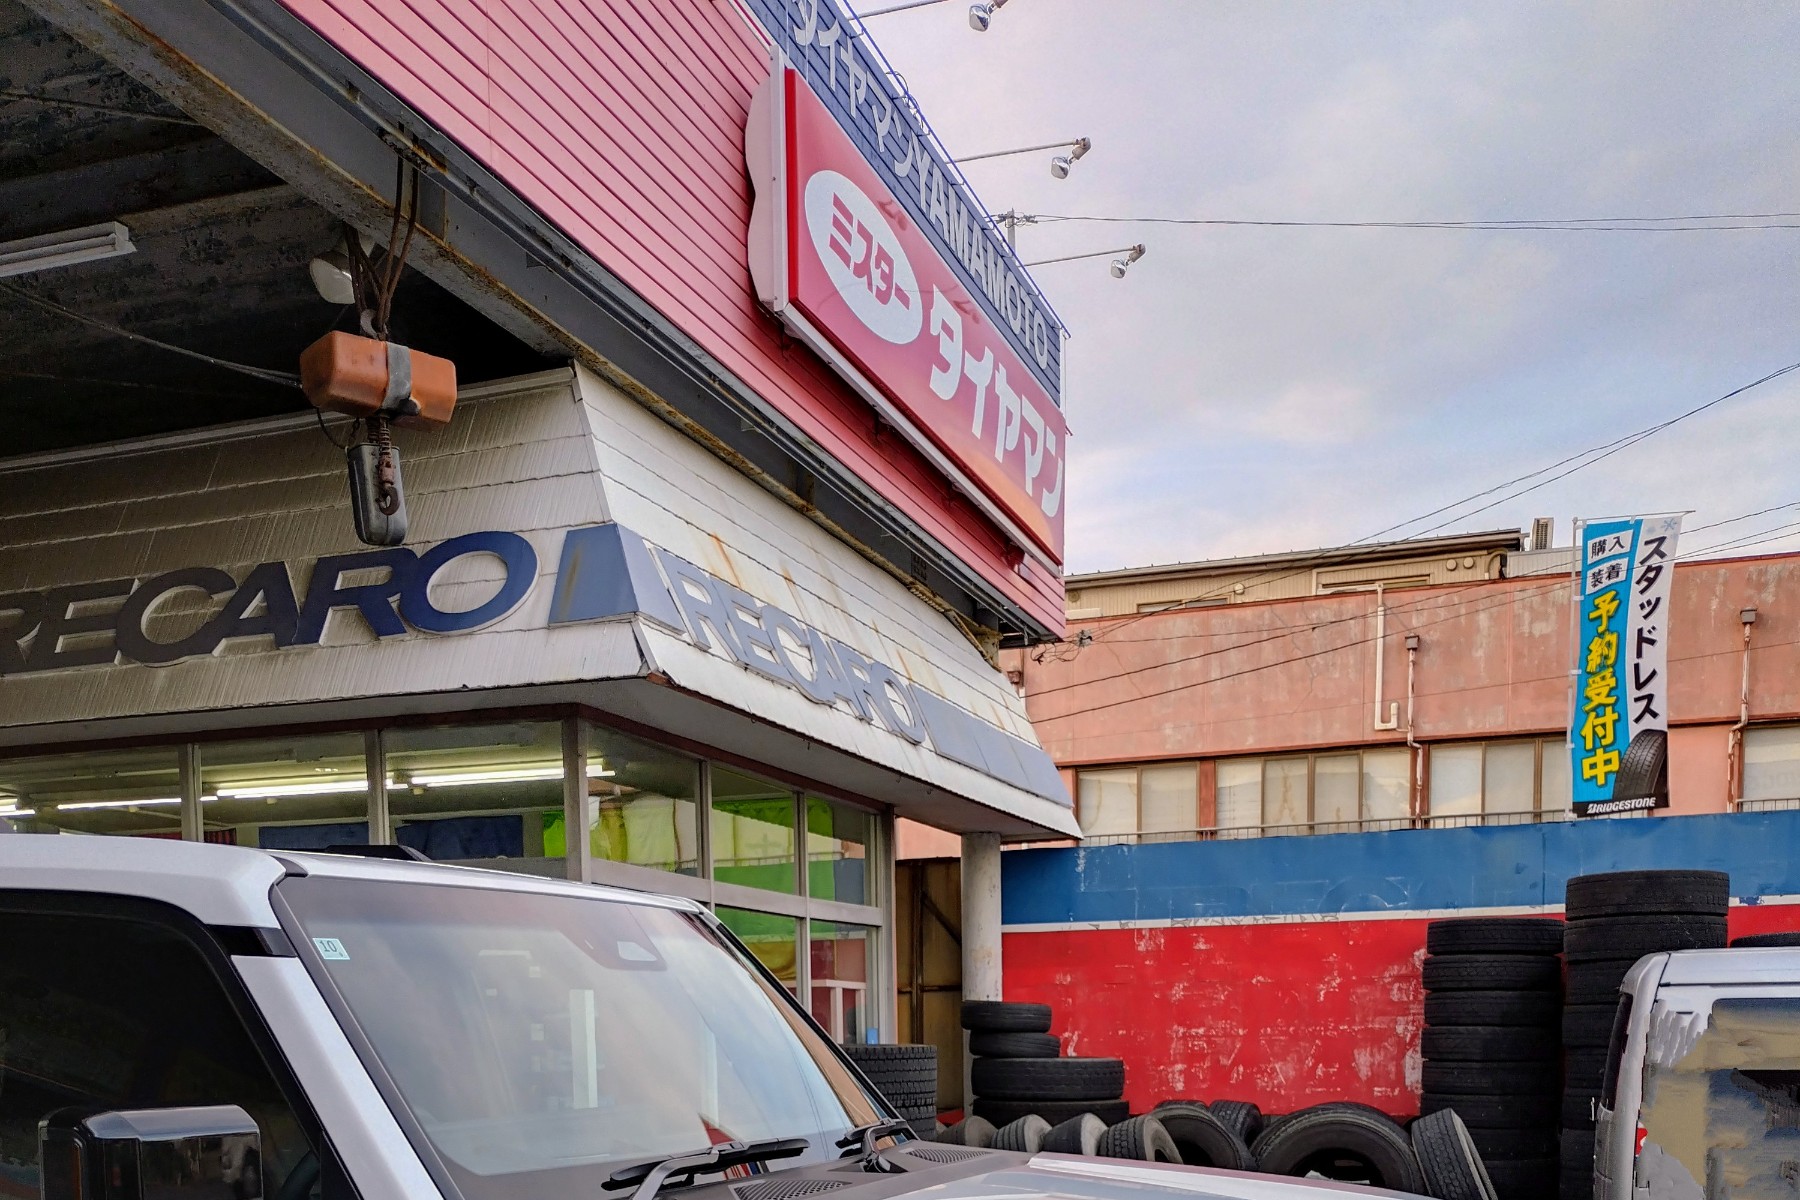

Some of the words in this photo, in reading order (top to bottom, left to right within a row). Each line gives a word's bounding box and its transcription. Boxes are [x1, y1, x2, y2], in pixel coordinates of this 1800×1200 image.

[829, 191, 911, 311] ミスター
[910, 130, 1049, 370] YAMAMOTO
[930, 283, 1063, 518] タイヤマン
[1590, 562, 1623, 588] 装着
[1591, 535, 1625, 559] 購入
[652, 545, 926, 746] RECARO
[1580, 589, 1621, 787] 予約受付中
[1633, 535, 1668, 725] スタッドレス
[1586, 796, 1657, 815] BRIDGESTONE
[319, 940, 338, 953] 10
